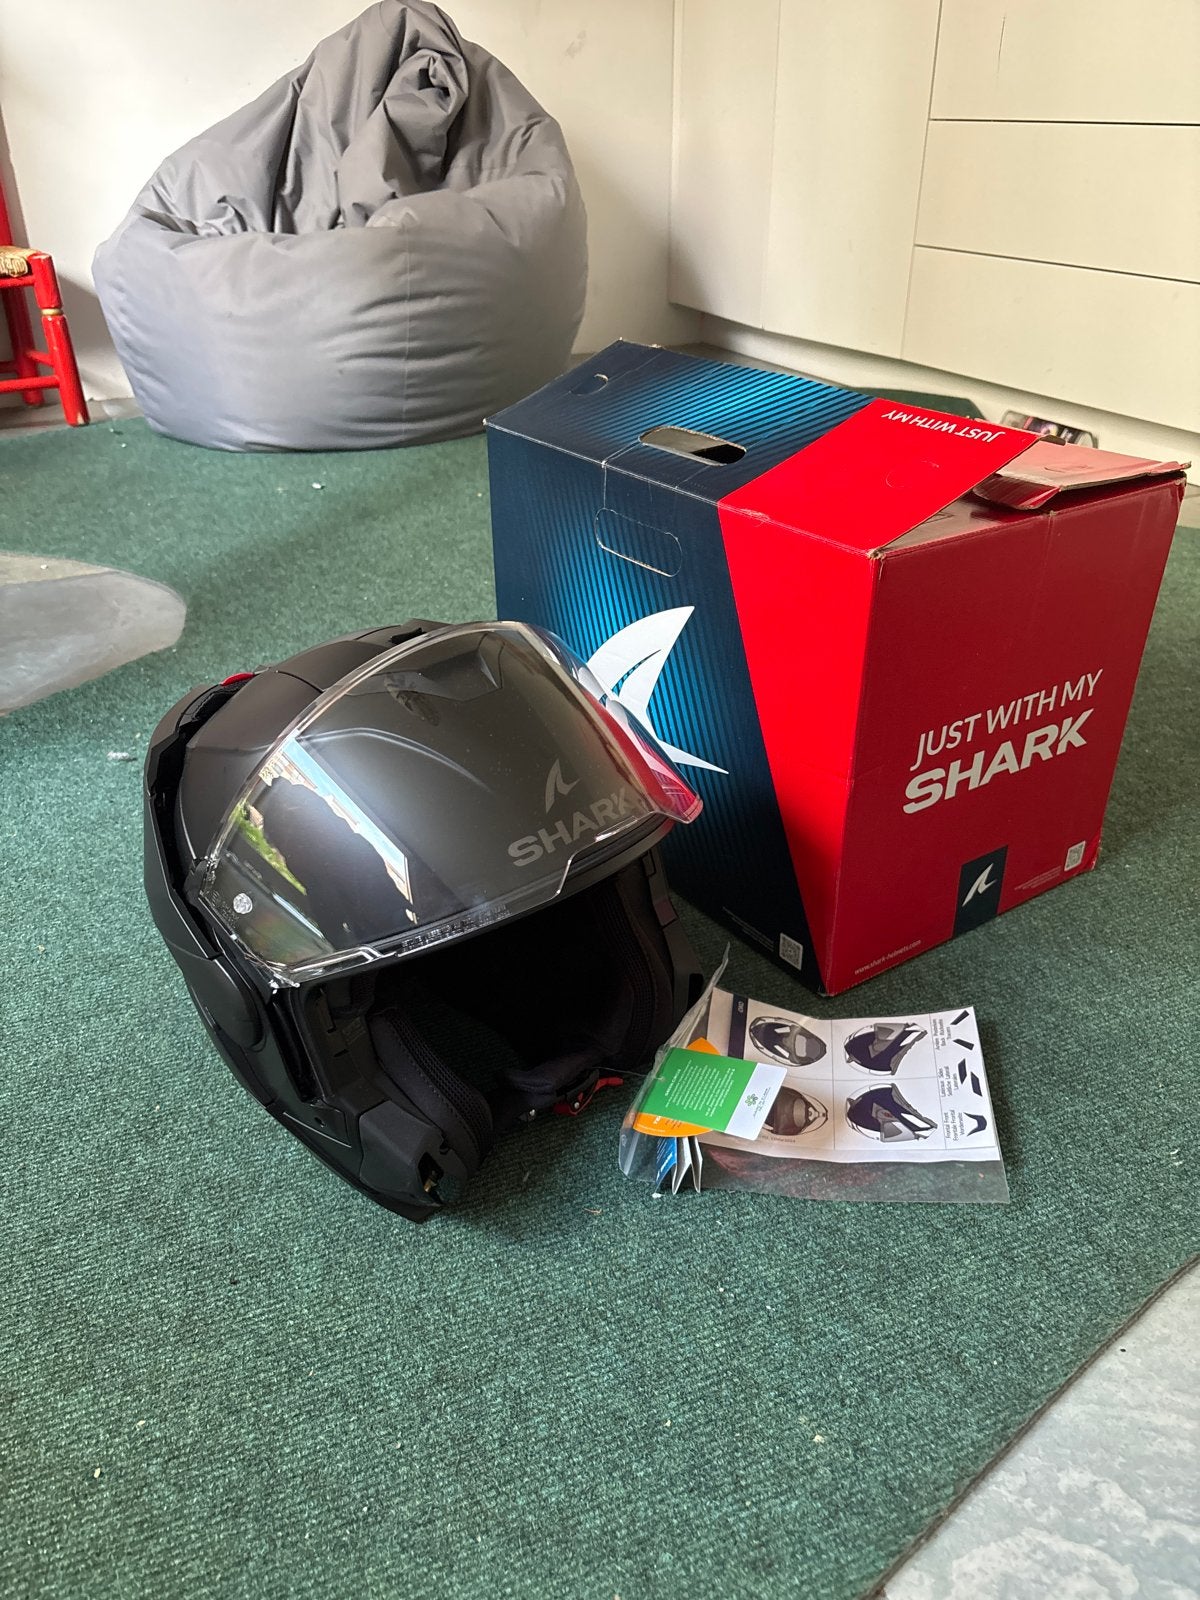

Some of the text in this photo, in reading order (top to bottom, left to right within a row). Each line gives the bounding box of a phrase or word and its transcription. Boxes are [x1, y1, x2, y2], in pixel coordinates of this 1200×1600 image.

[881, 409, 1006, 443] JUST WITH MY
[902, 707, 1095, 814] SHARK
[910, 668, 1104, 771] JUST WITH MY
[507, 787, 638, 867] SHARK
